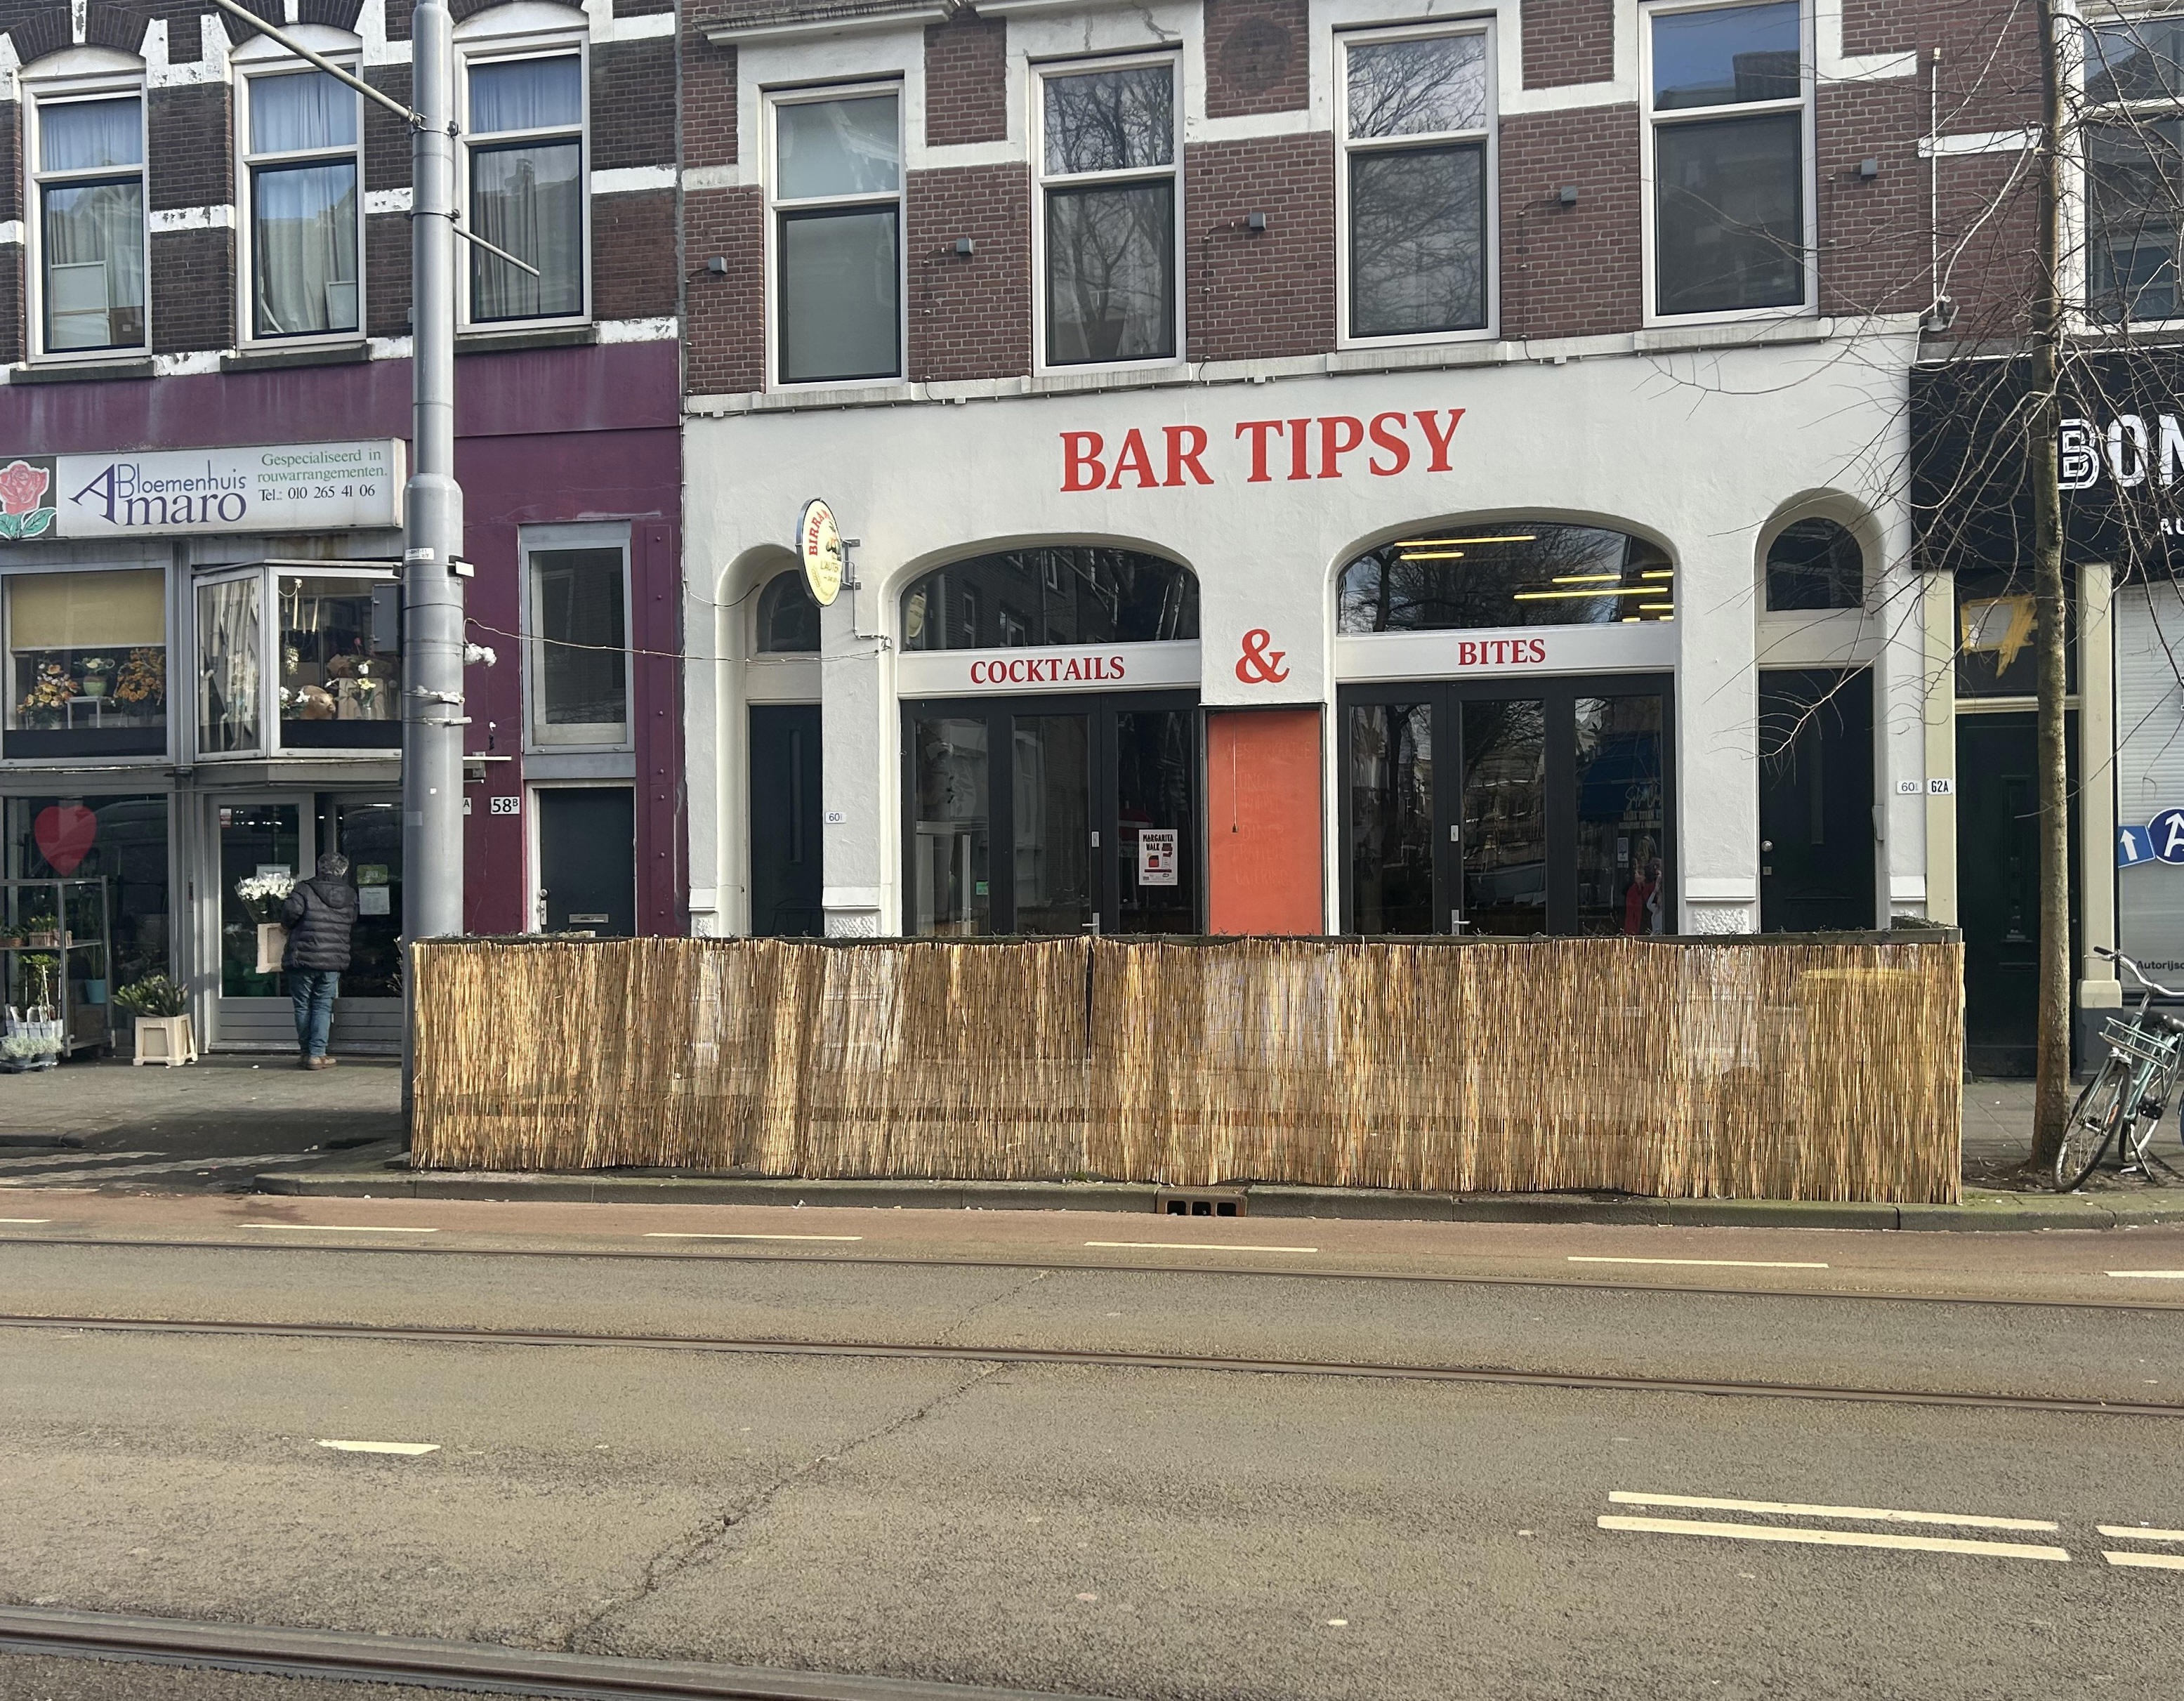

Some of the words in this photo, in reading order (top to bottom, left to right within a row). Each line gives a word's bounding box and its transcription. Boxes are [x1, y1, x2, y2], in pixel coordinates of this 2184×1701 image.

[261, 449, 362, 467] Gespecialiseerd
[369, 448, 381, 461] in
[1059, 425, 1214, 492] BAR
[1235, 408, 1466, 482] TIPSY
[114, 459, 246, 499] Bloemenhuis
[257, 466, 388, 482] rouwarrangementen.
[68, 464, 246, 526] Amaro
[288, 486, 308, 499] 010
[314, 485, 335, 499] 265
[341, 485, 353, 497] 41
[359, 484, 376, 497] 06
[808, 511, 825, 556] BIRRA
[1235, 629, 1289, 684] &
[1458, 638, 1546, 666] BITES
[971, 656, 1124, 685] COCKTAILS
[1931, 780, 1949, 793] 62A
[1143, 834, 1173, 842] MARGARITA
